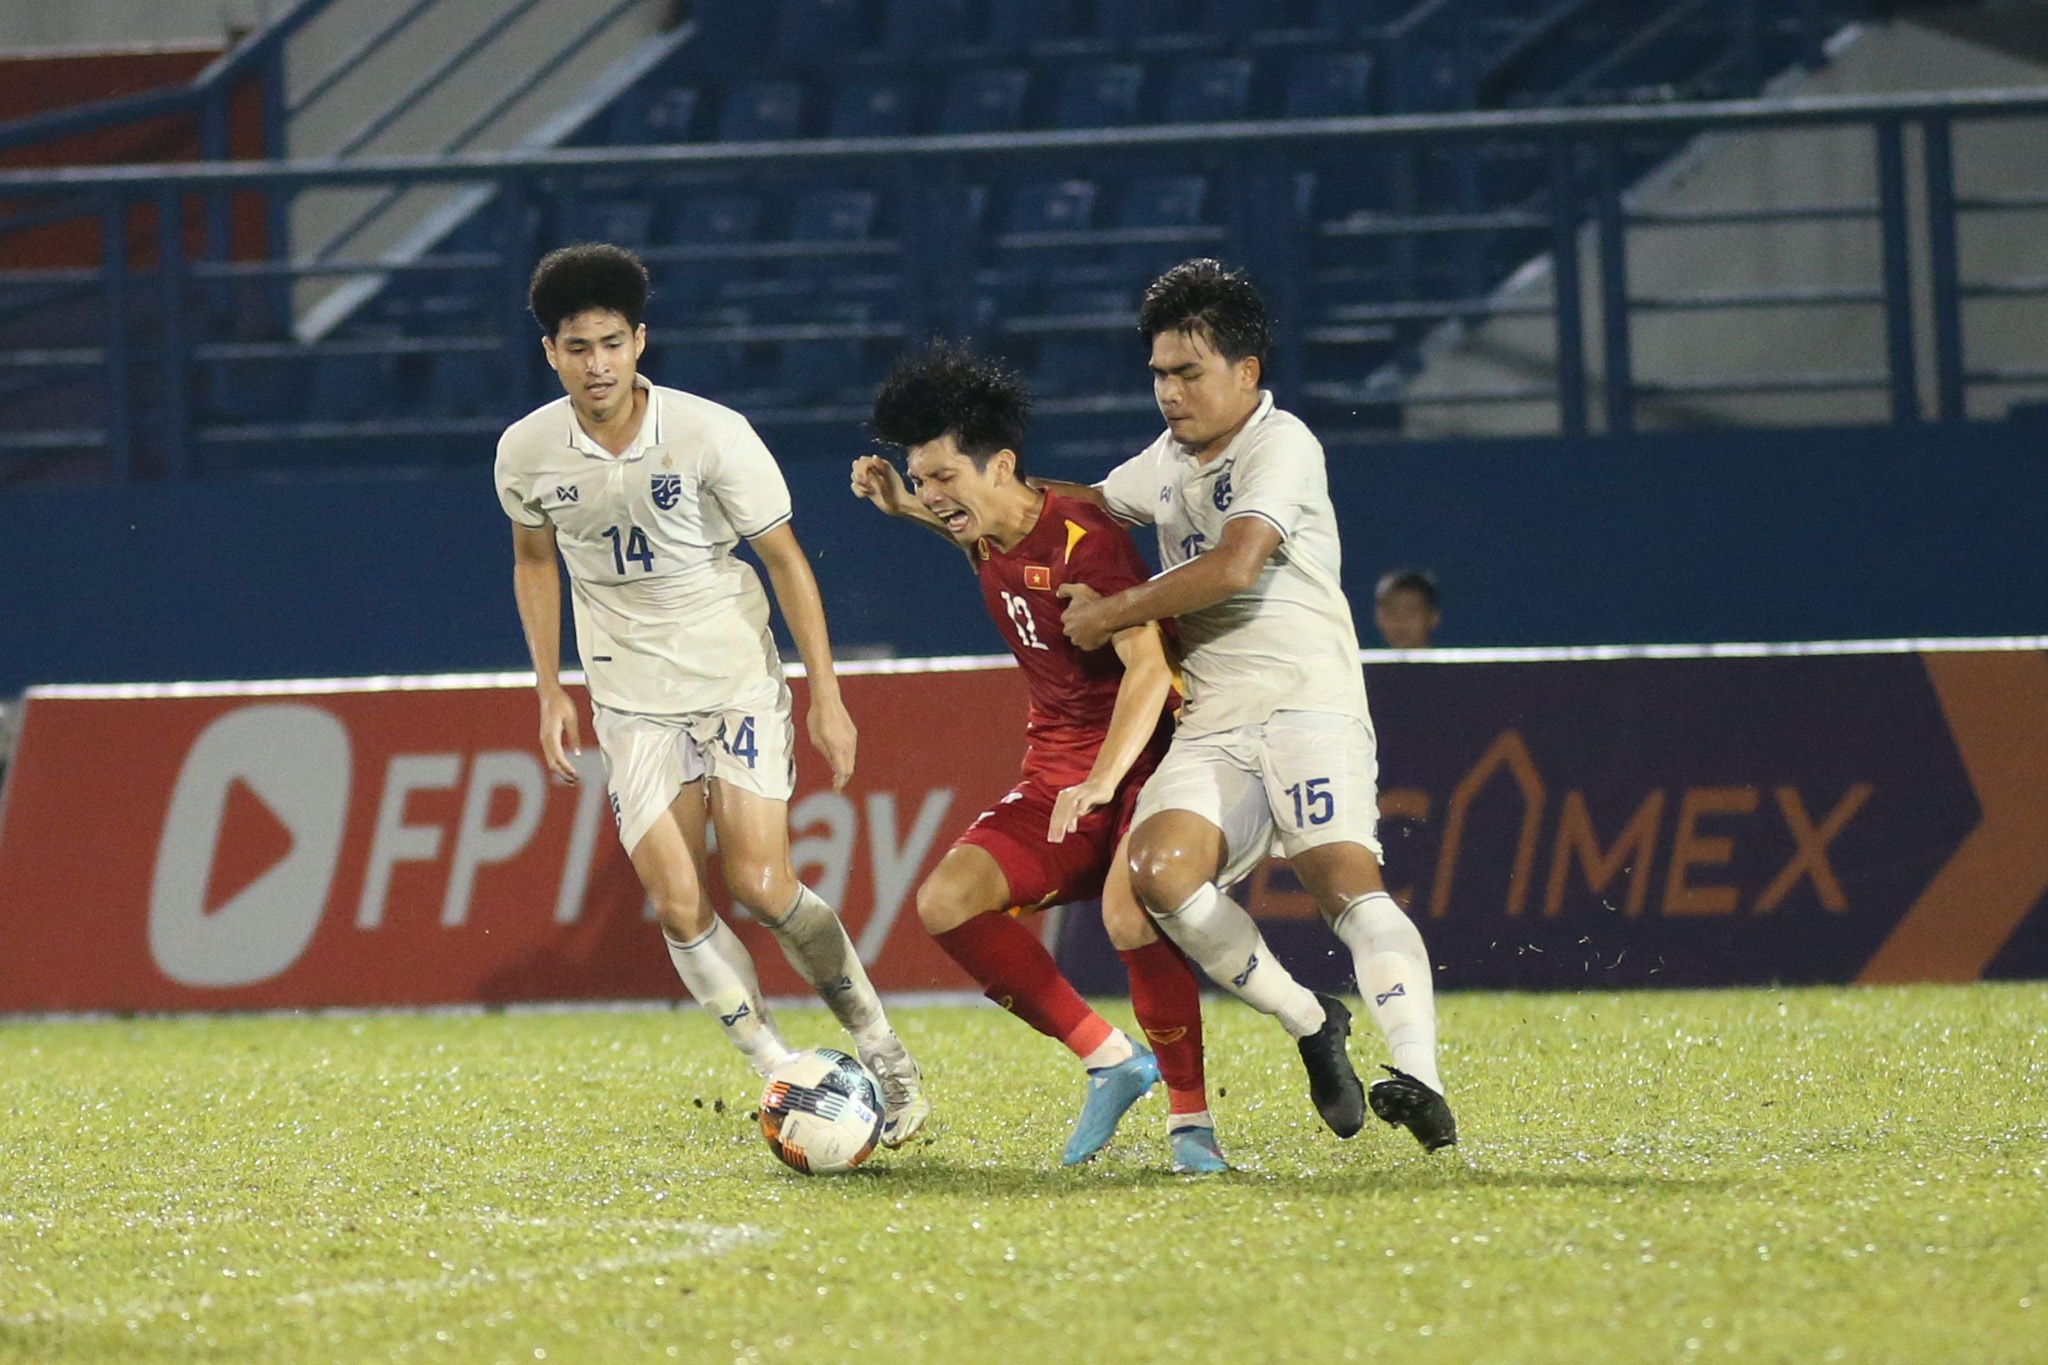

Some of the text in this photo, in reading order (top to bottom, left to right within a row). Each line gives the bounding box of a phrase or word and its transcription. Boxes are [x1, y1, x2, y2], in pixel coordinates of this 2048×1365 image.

[602, 525, 655, 575] 14
[1000, 591, 1049, 651] 12
[1284, 777, 1335, 828] 15
[355, 747, 955, 966] FPT ay
